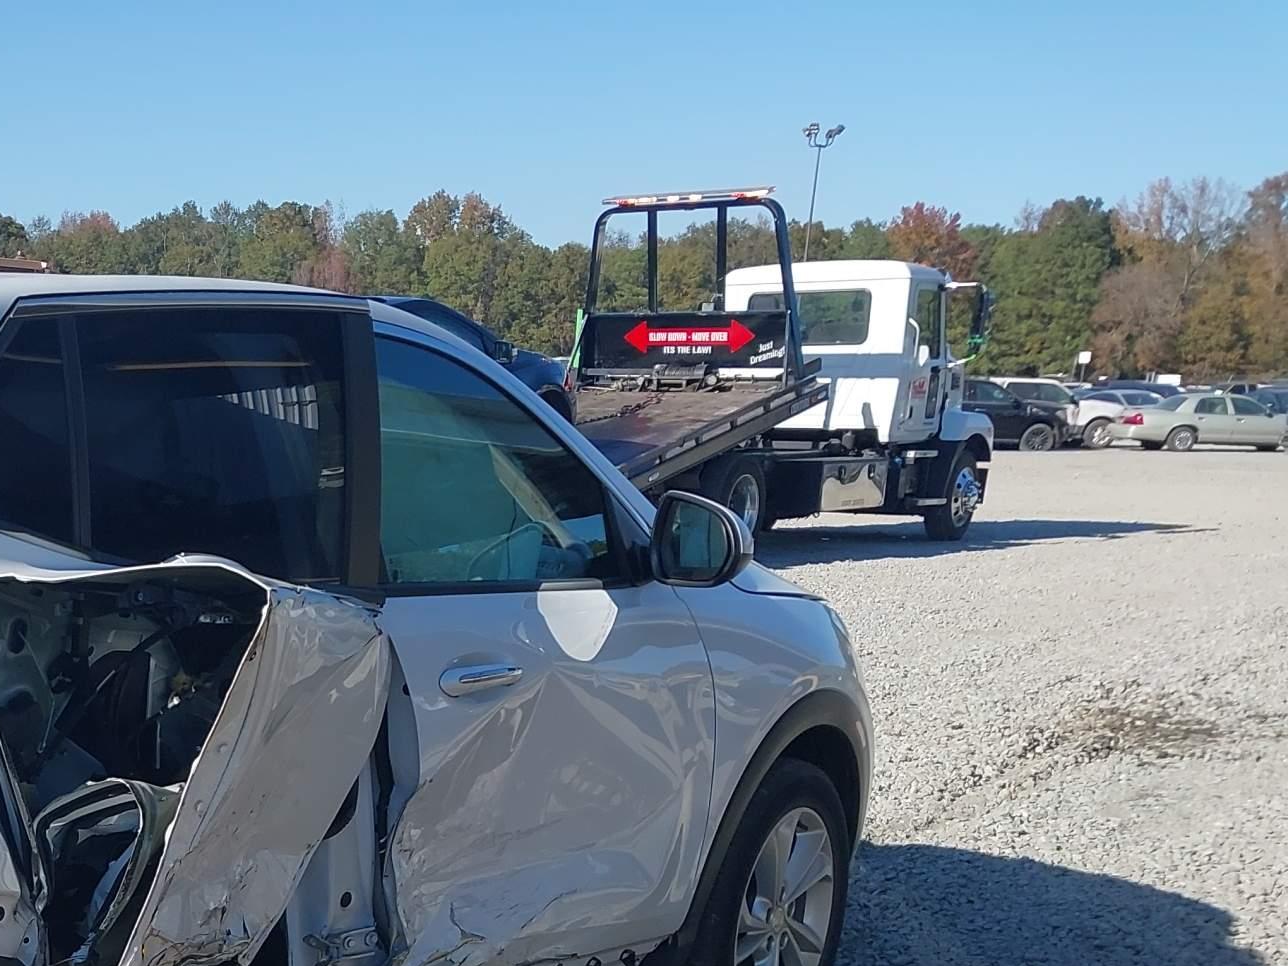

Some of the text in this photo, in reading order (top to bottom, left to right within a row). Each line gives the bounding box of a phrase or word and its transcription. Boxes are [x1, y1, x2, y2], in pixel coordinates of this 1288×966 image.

[648, 331, 667, 342] SLOW
[667, 331, 687, 342] DOWN
[691, 331, 710, 342] MOVE
[710, 331, 729, 342] OVER
[677, 345, 691, 355] THE
[758, 340, 774, 353] Just
